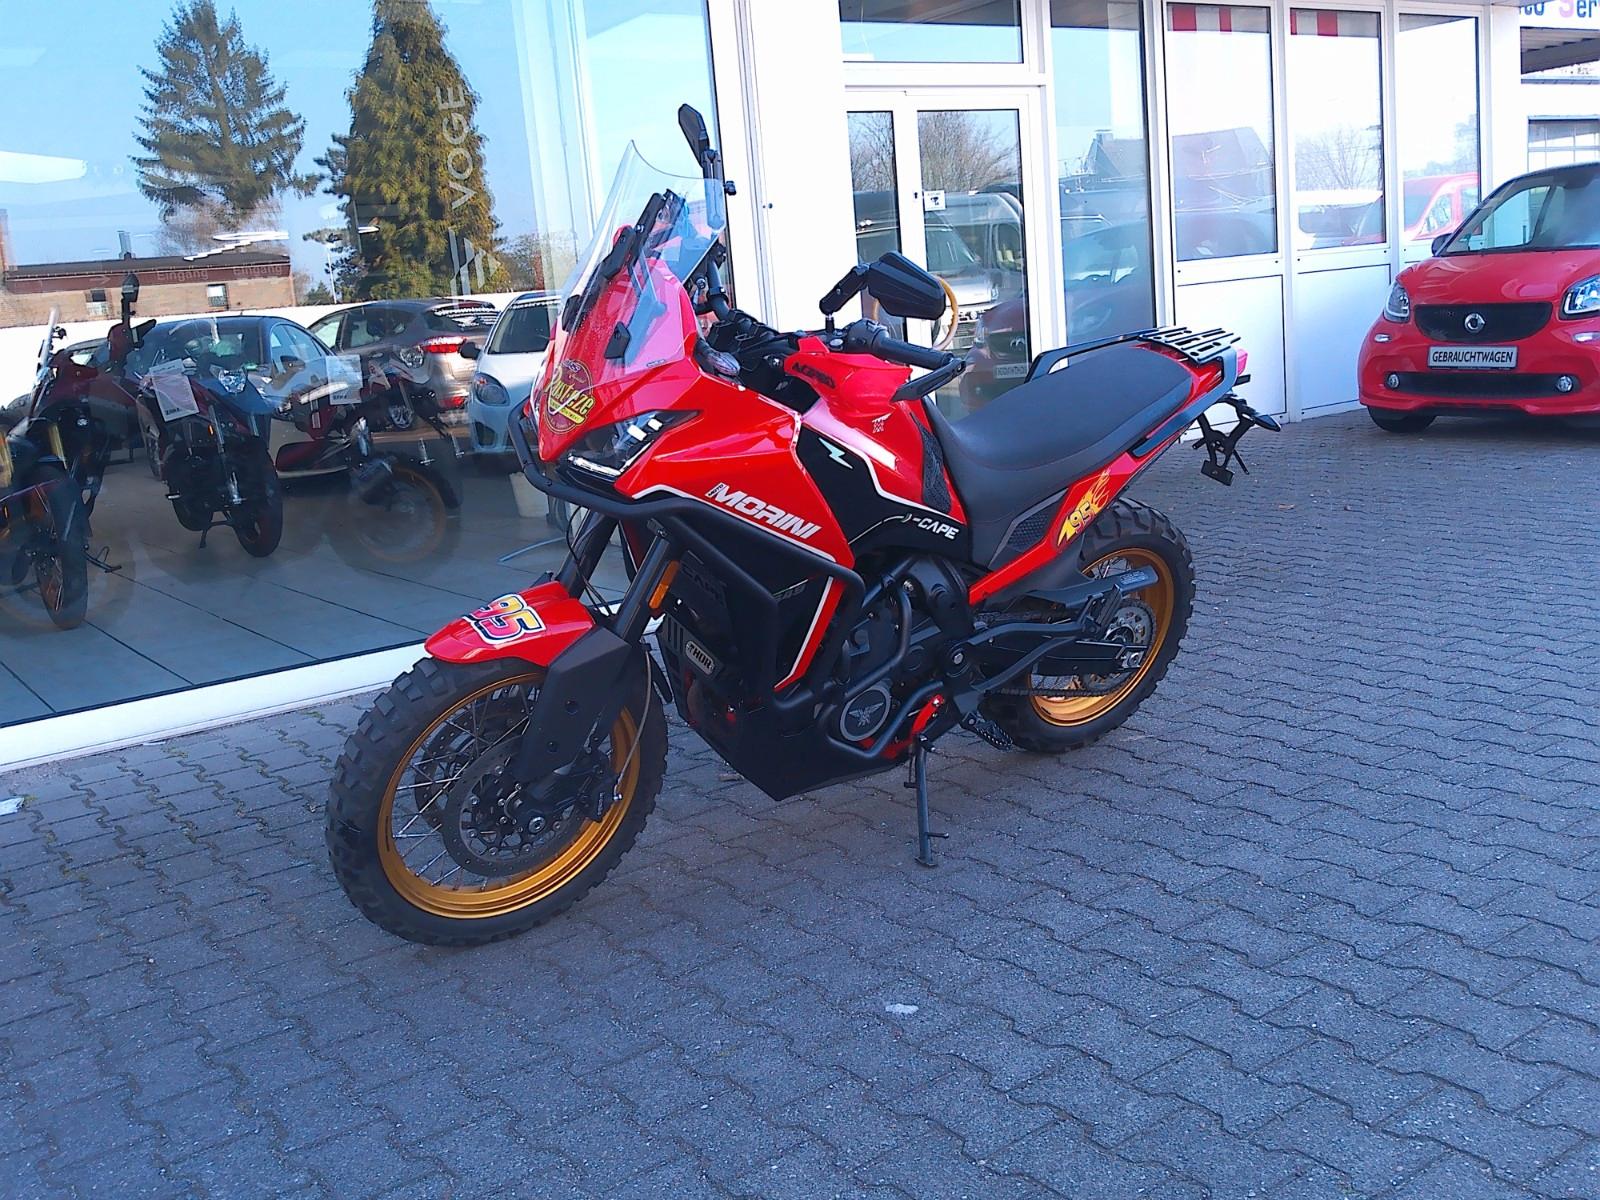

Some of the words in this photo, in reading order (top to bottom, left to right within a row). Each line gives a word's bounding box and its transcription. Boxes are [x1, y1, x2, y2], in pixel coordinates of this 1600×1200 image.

[436, 85, 477, 210] VOGE
[157, 269, 209, 281] Eingang
[1432, 351, 1514, 363] GEBRAUCHTWAGEN
[714, 485, 822, 540] MORINI
[1069, 501, 1097, 534] 95
[462, 593, 547, 645] 95
[687, 643, 715, 670] THOR
